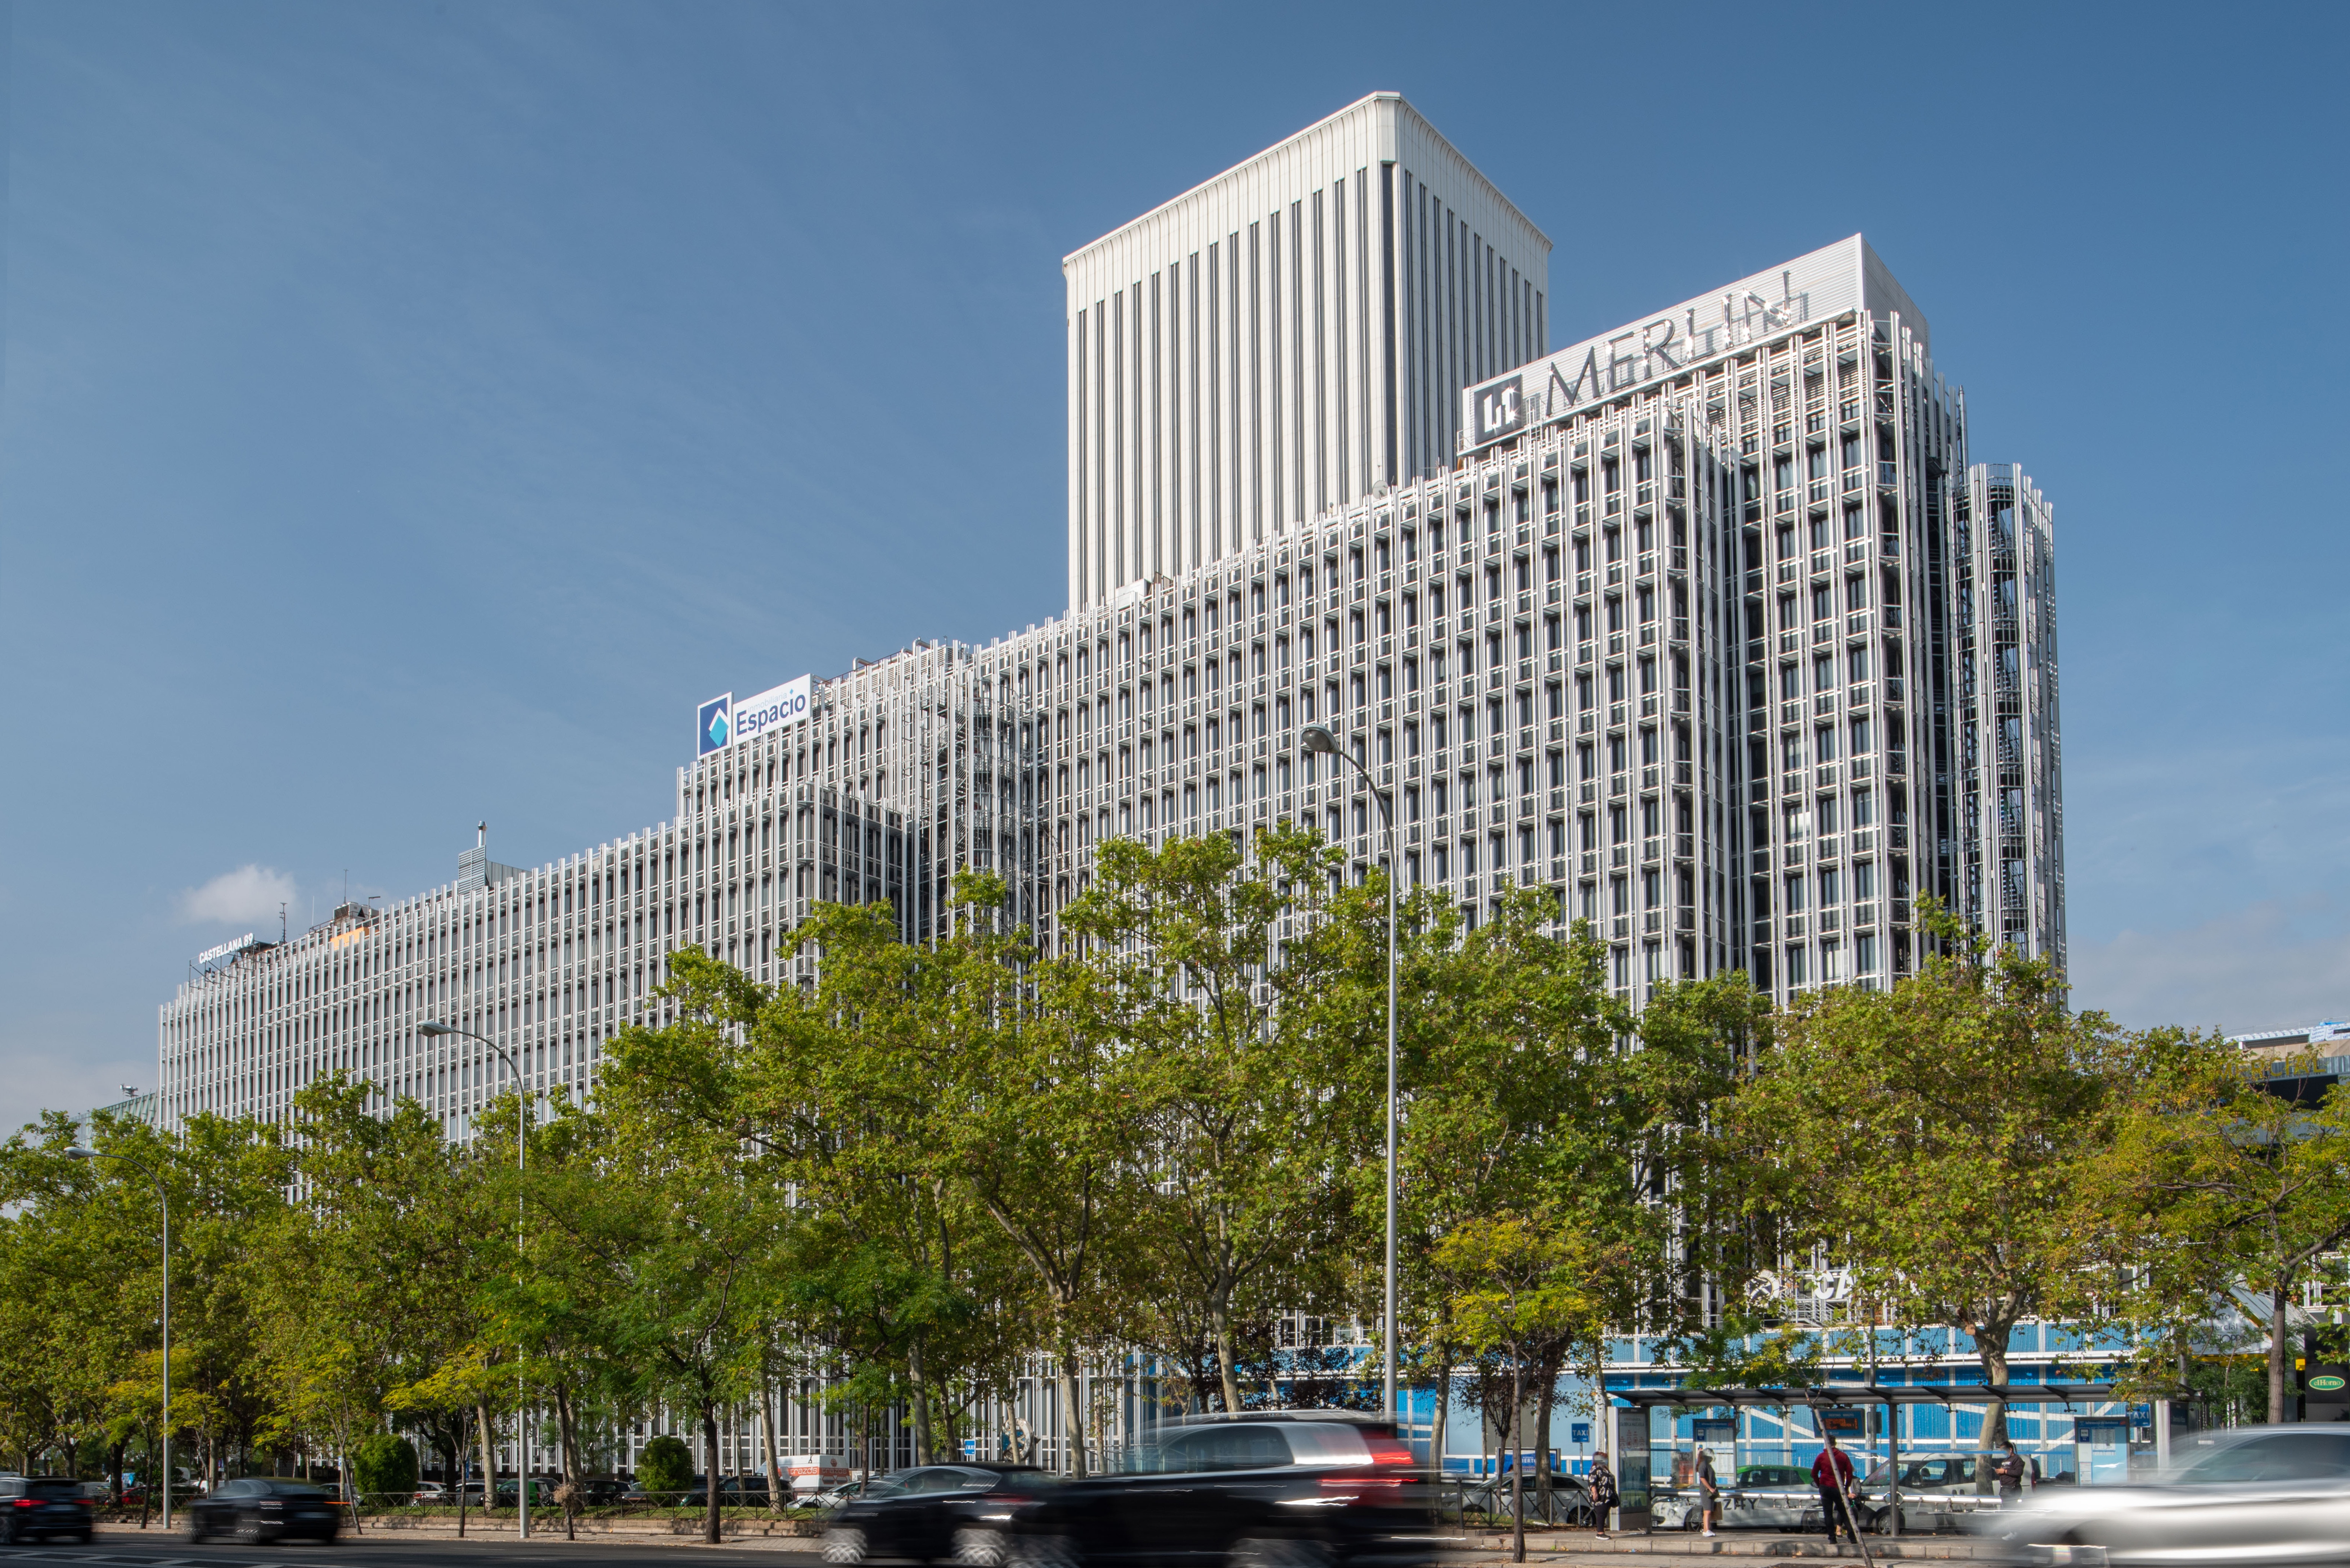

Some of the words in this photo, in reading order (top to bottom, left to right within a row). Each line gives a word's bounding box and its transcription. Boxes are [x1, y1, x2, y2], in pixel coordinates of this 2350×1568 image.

[1546, 270, 1792, 417] MERLIN
[737, 689, 806, 736] Espacio
[748, 692, 787, 713] inmobiliaria
[199, 937, 243, 964] CASTELLANA
[244, 932, 253, 947] 89
